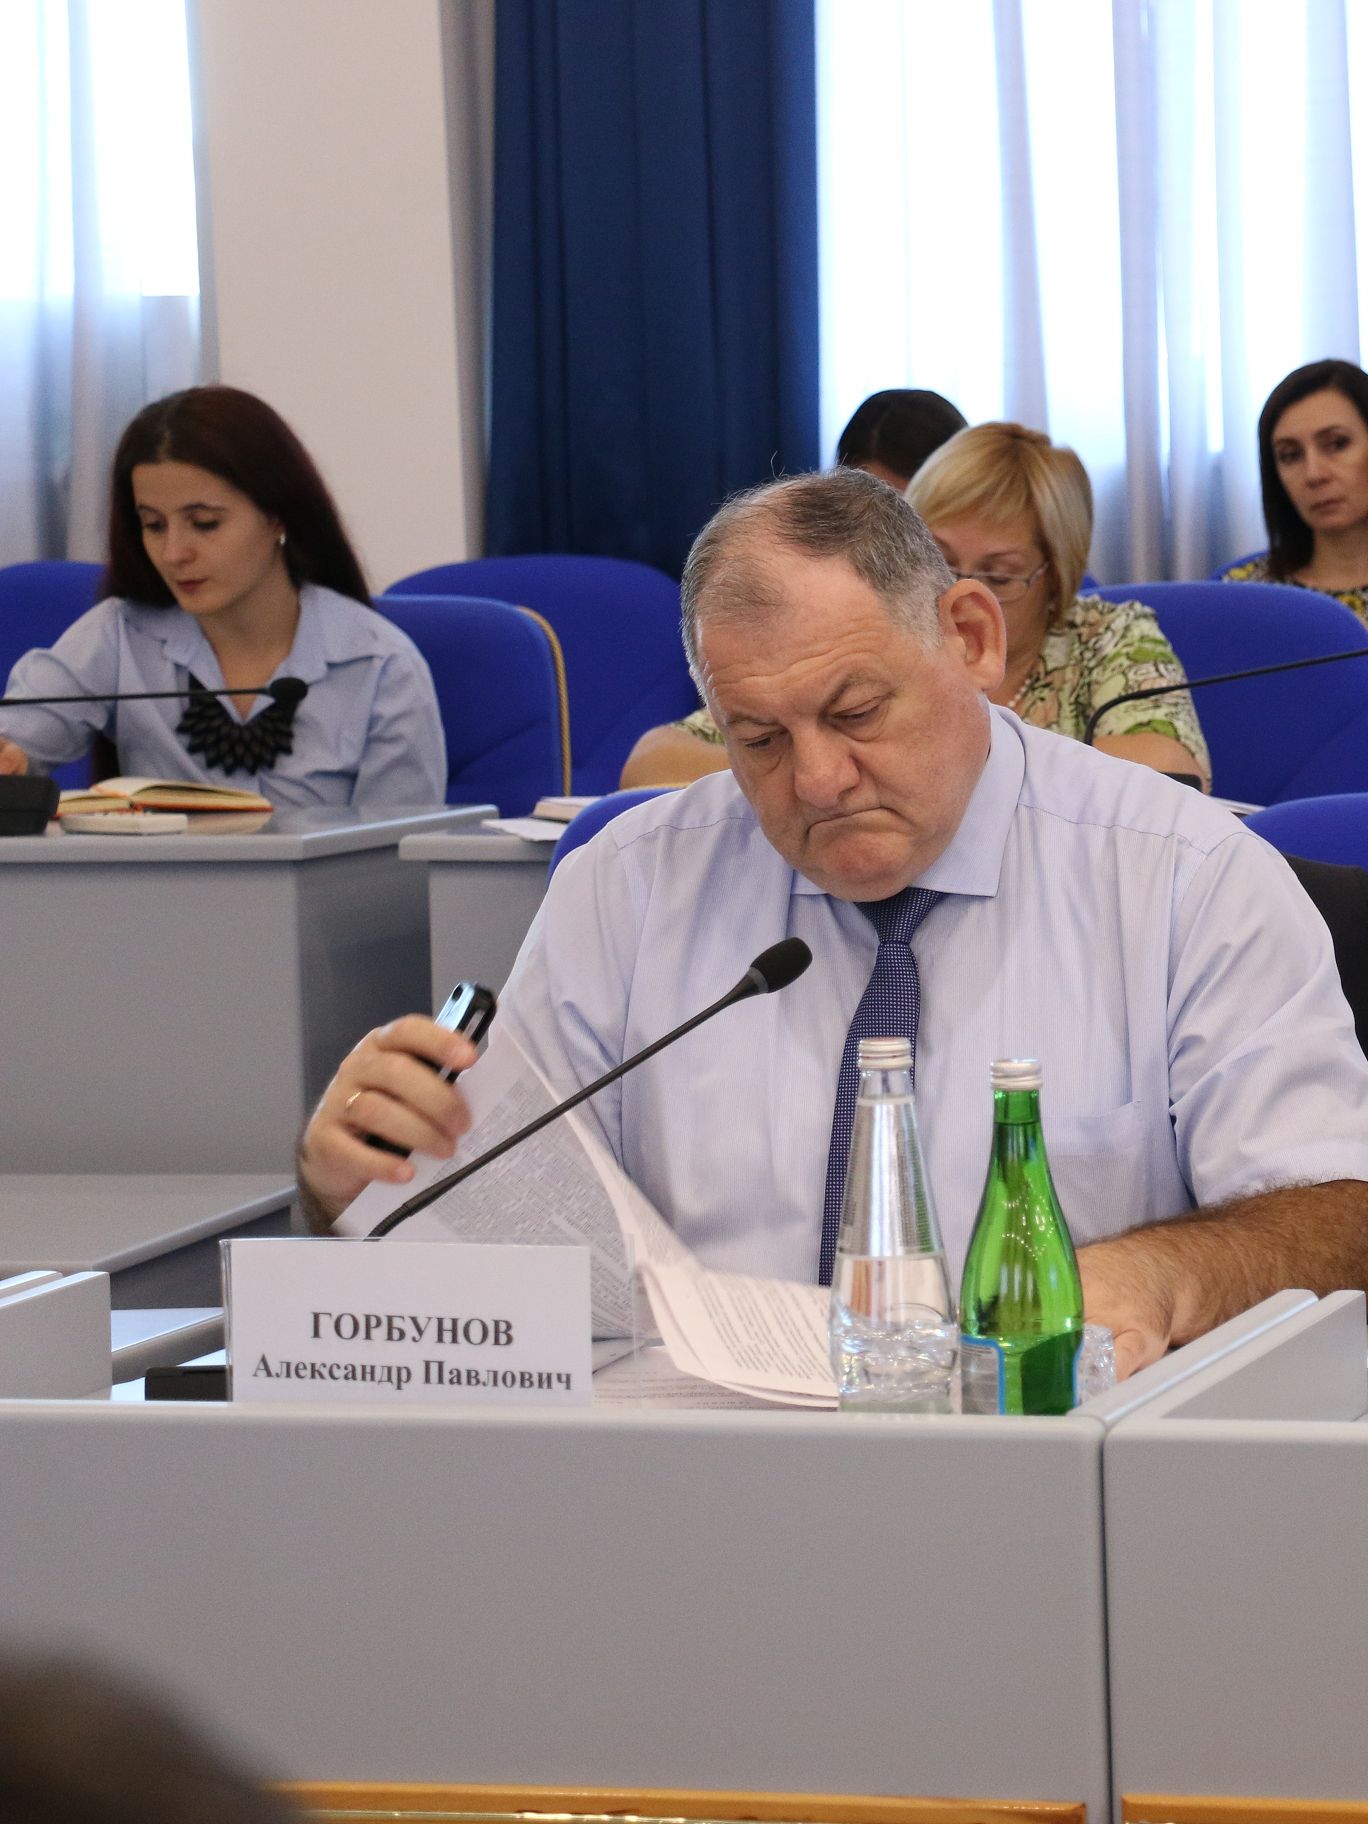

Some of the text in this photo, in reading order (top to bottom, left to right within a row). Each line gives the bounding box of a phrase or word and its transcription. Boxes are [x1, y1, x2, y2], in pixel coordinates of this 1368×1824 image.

[311, 1311, 514, 1346] ГОРБУНОВ
[252, 1354, 573, 1391] Александр Павлович
